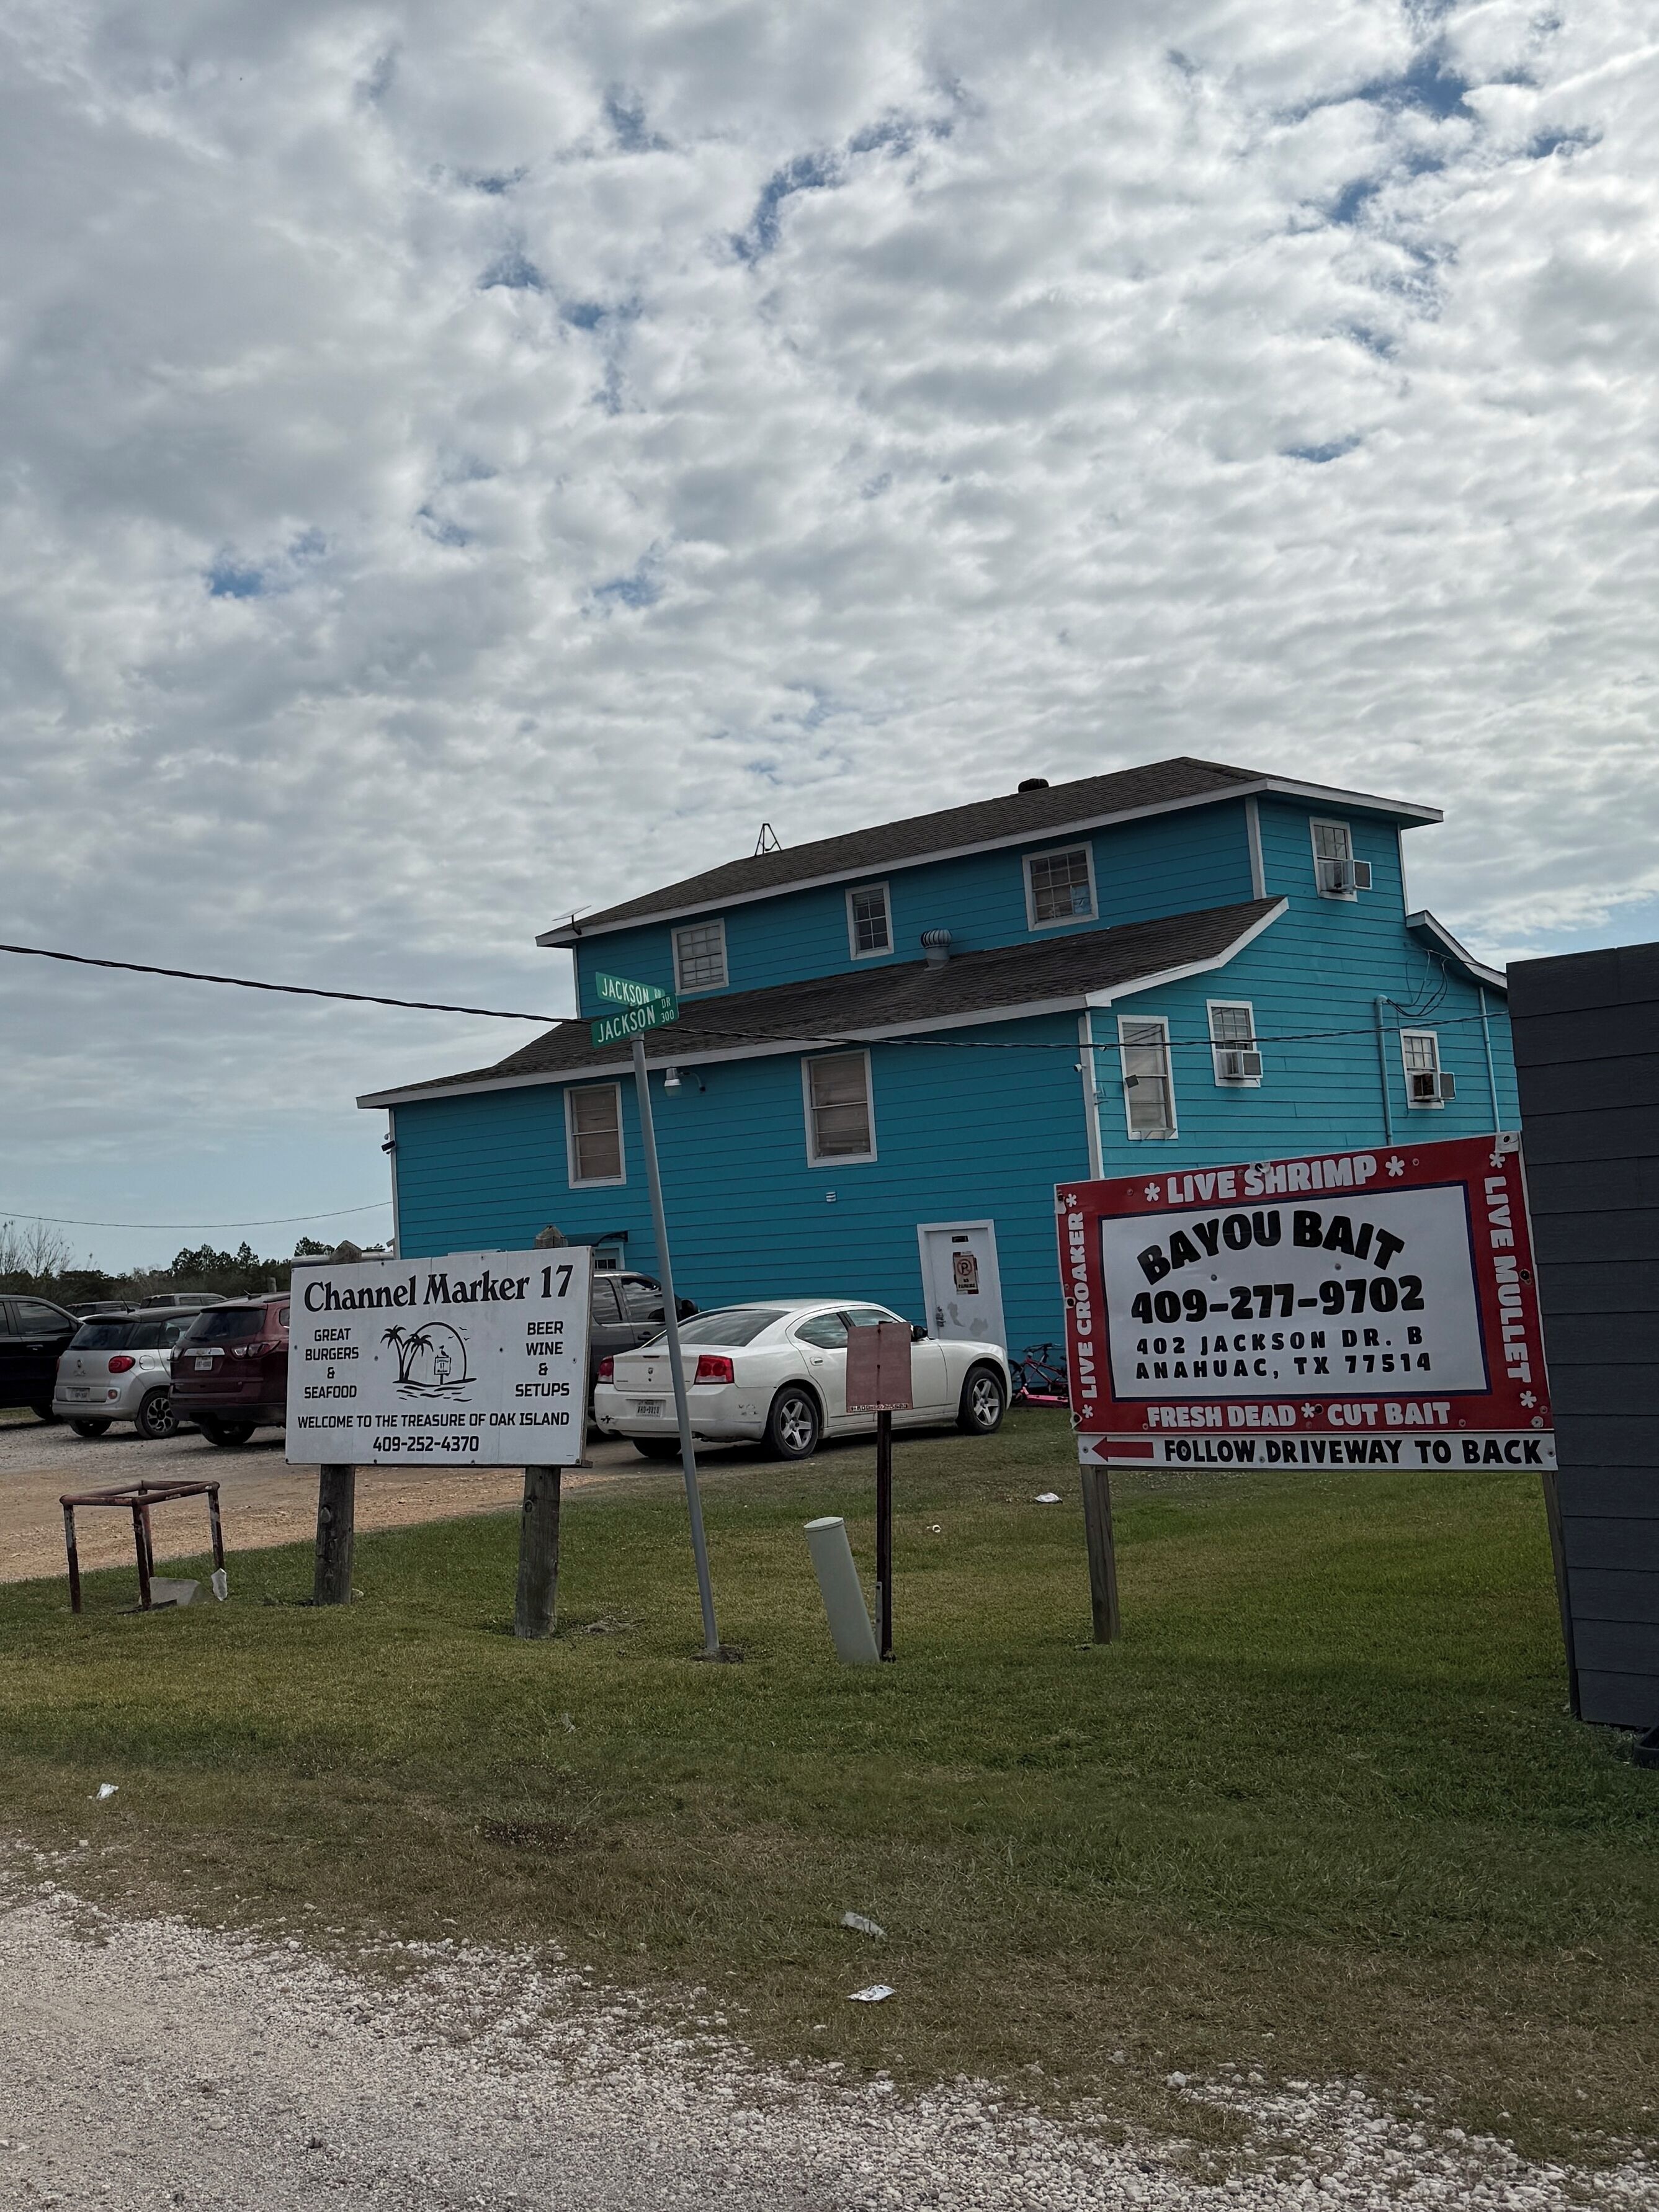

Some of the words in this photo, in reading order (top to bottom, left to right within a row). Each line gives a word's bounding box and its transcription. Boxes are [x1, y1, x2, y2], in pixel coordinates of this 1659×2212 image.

[602, 978, 650, 1005] JACKSON
[597, 1005, 655, 1043] JACKSON
[661, 997, 671, 1008] DR
[661, 1010, 674, 1022] 300
[1168, 1172, 1236, 1204] LIVE
[1244, 1155, 1377, 1196] SHRIMP
[1484, 1175, 1514, 1249] LIVE
[1137, 1210, 1281, 1286] BAYOU
[1293, 1209, 1405, 1270] BAIT
[1068, 1211, 1093, 1336] CROAKER
[305, 1276, 416, 1312] Channel
[424, 1270, 529, 1305] Marker
[541, 1265, 573, 1298] 17
[1131, 1275, 1424, 1324] 409-277-9702
[527, 1321, 563, 1335] BEER
[1495, 1255, 1531, 1383] MULLET
[315, 1328, 351, 1341] GREAT
[1137, 1336, 1186, 1355] 402
[1201, 1331, 1326, 1352] JACKSON
[1343, 1328, 1392, 1348] DR.
[1408, 1326, 1423, 1345] B
[305, 1347, 359, 1360] BURGERS
[526, 1341, 563, 1355] WINE
[327, 1367, 335, 1379] &
[539, 1362, 548, 1375] &
[1080, 1342, 1098, 1399] LIVE
[1135, 1358, 1279, 1379] ANAHUAC,
[1294, 1356, 1330, 1375] TX
[1346, 1352, 1431, 1373] 77514
[305, 1385, 357, 1399] SEAFOOD
[516, 1383, 570, 1397] SETUPS
[298, 1416, 353, 1429] WELCOME
[357, 1415, 372, 1427] TO
[375, 1414, 397, 1427] THE
[401, 1414, 465, 1426] TREASURE
[470, 1413, 485, 1426] OF
[490, 1412, 516, 1425] OAK
[519, 1412, 569, 1425] ISLAND
[1147, 1405, 1222, 1427] FRESH
[1227, 1404, 1295, 1427] DEAD
[1328, 1403, 1378, 1426] CUT
[1382, 1402, 1449, 1425] BAIT
[373, 1436, 479, 1452] 409-252-4370
[1164, 1439, 1255, 1463] FOLLOW
[1266, 1439, 1402, 1464] DRIVEWAY
[1415, 1440, 1451, 1464] TO
[1464, 1439, 1543, 1464] BACK
